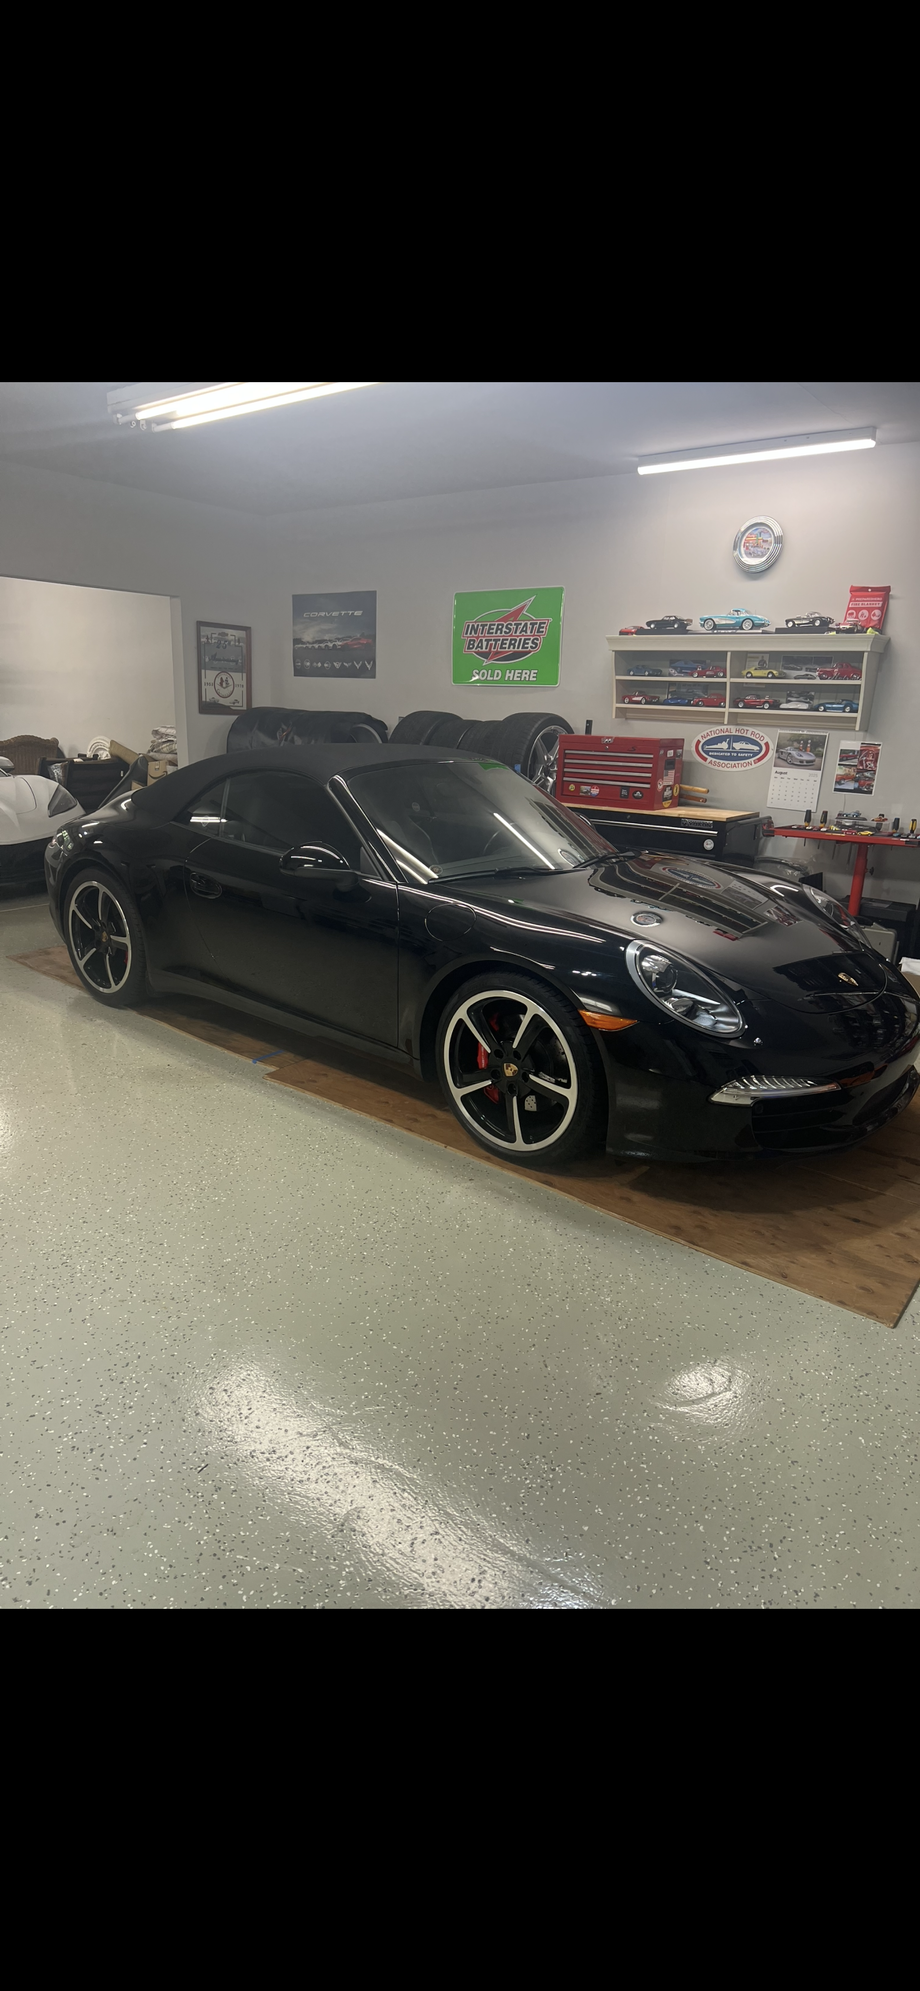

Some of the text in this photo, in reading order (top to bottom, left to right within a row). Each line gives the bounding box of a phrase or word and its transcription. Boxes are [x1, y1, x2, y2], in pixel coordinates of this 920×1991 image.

[303, 610, 363, 618] CORVETTE
[464, 621, 547, 636] INTERSTATE
[466, 637, 540, 651] BATTERIES
[472, 669, 538, 681] SOLD HERE
[700, 727, 765, 742] NATIONAL HOT ROD
[708, 759, 753, 769] ASSOCIATION
